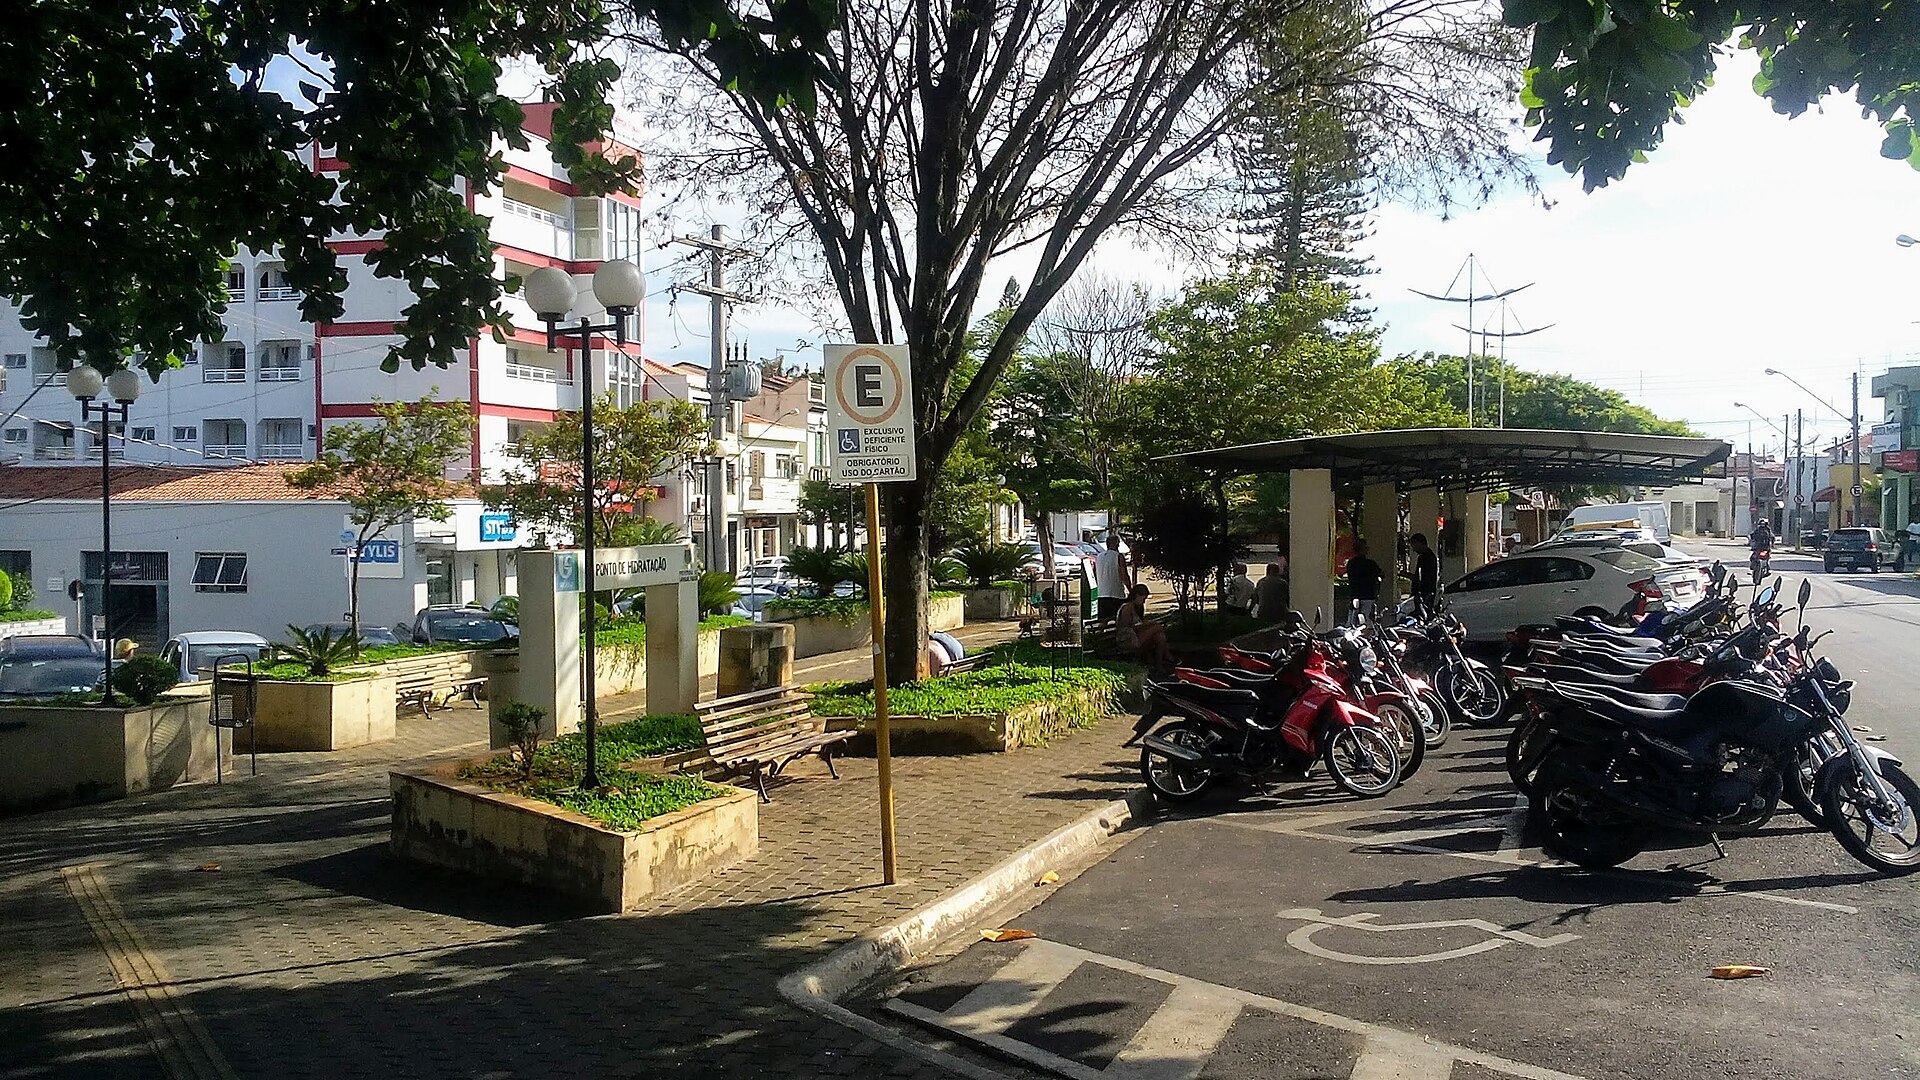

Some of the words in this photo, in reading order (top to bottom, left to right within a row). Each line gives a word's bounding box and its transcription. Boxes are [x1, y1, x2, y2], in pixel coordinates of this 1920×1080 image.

[855, 365, 884, 407] E
[864, 427, 904, 435] EXCLUSIVO
[864, 436, 906, 444] DEFICIENTE
[865, 445, 888, 453] FÍSICO
[847, 457, 900, 467] OBRIGATÓRIO
[842, 469, 859, 477] USO
[861, 468, 872, 476] DO
[873, 466, 906, 476] CARTÃO
[595, 561, 617, 576] PONTO
[618, 561, 626, 574] DE
[628, 556, 667, 574] HIDRATAÇÃO
